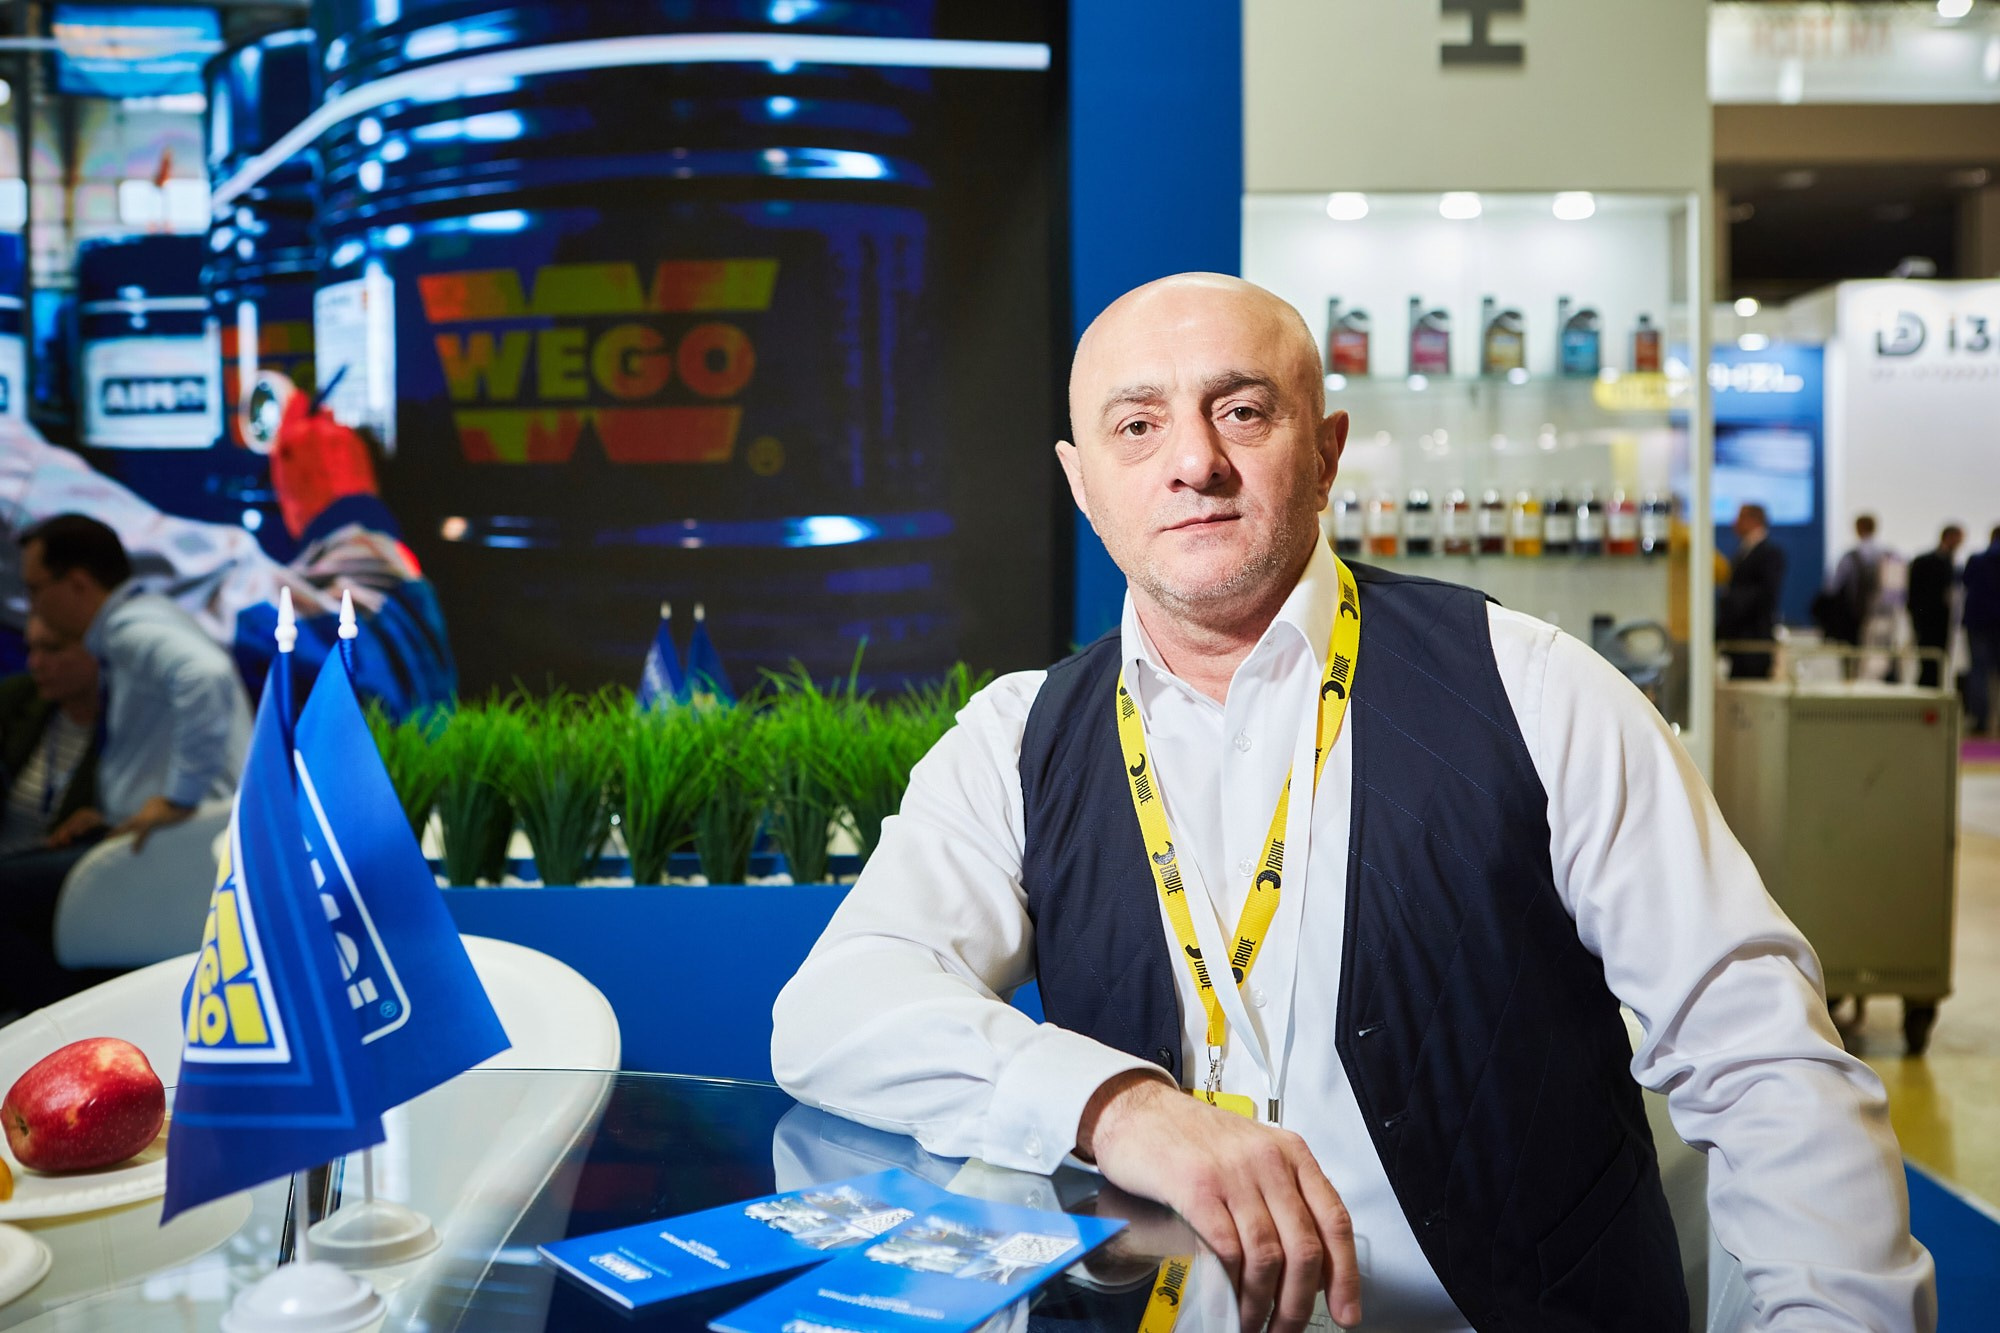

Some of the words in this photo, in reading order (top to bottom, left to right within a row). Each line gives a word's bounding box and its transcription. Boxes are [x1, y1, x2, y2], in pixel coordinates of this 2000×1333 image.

[435, 322, 756, 398] WEGO
[1330, 652, 1351, 683] DRIVE
[1134, 774, 1154, 806] DRIVE
[1265, 838, 1285, 871] DRIVE
[1159, 863, 1185, 897] DRIVE
[1232, 935, 1257, 969] DRIVE
